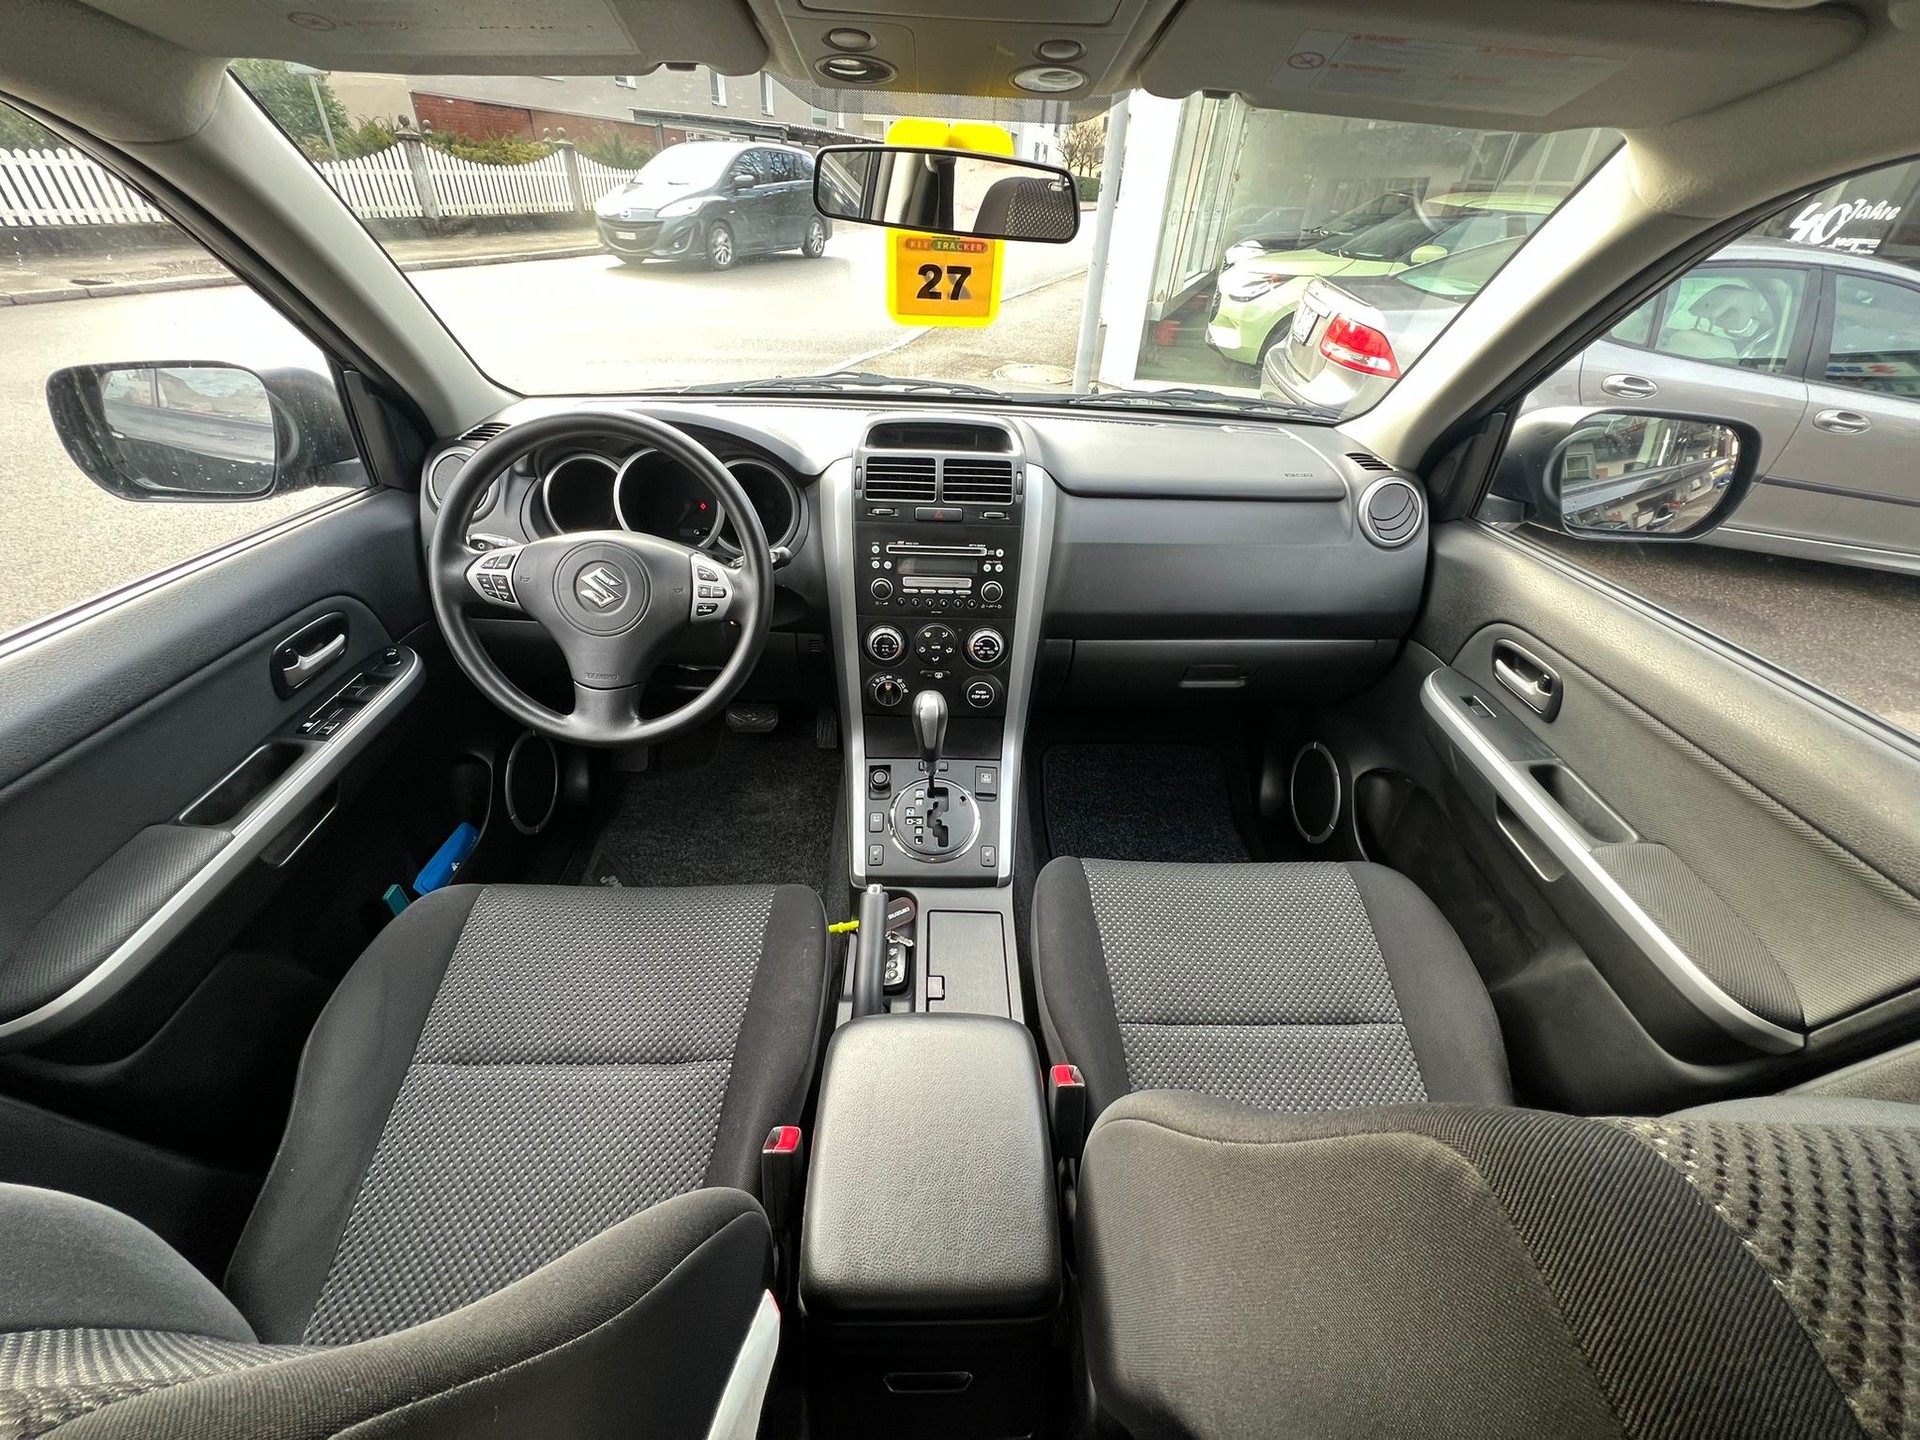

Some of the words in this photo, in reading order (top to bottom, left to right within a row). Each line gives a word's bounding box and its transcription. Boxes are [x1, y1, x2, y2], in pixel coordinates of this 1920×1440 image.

[1787, 201, 1853, 244] 40
[1848, 198, 1902, 221] Jahre
[936, 241, 983, 252] TRACKER
[916, 263, 972, 301] 27
[906, 808, 915, 817] N
[915, 837, 922, 845] L
